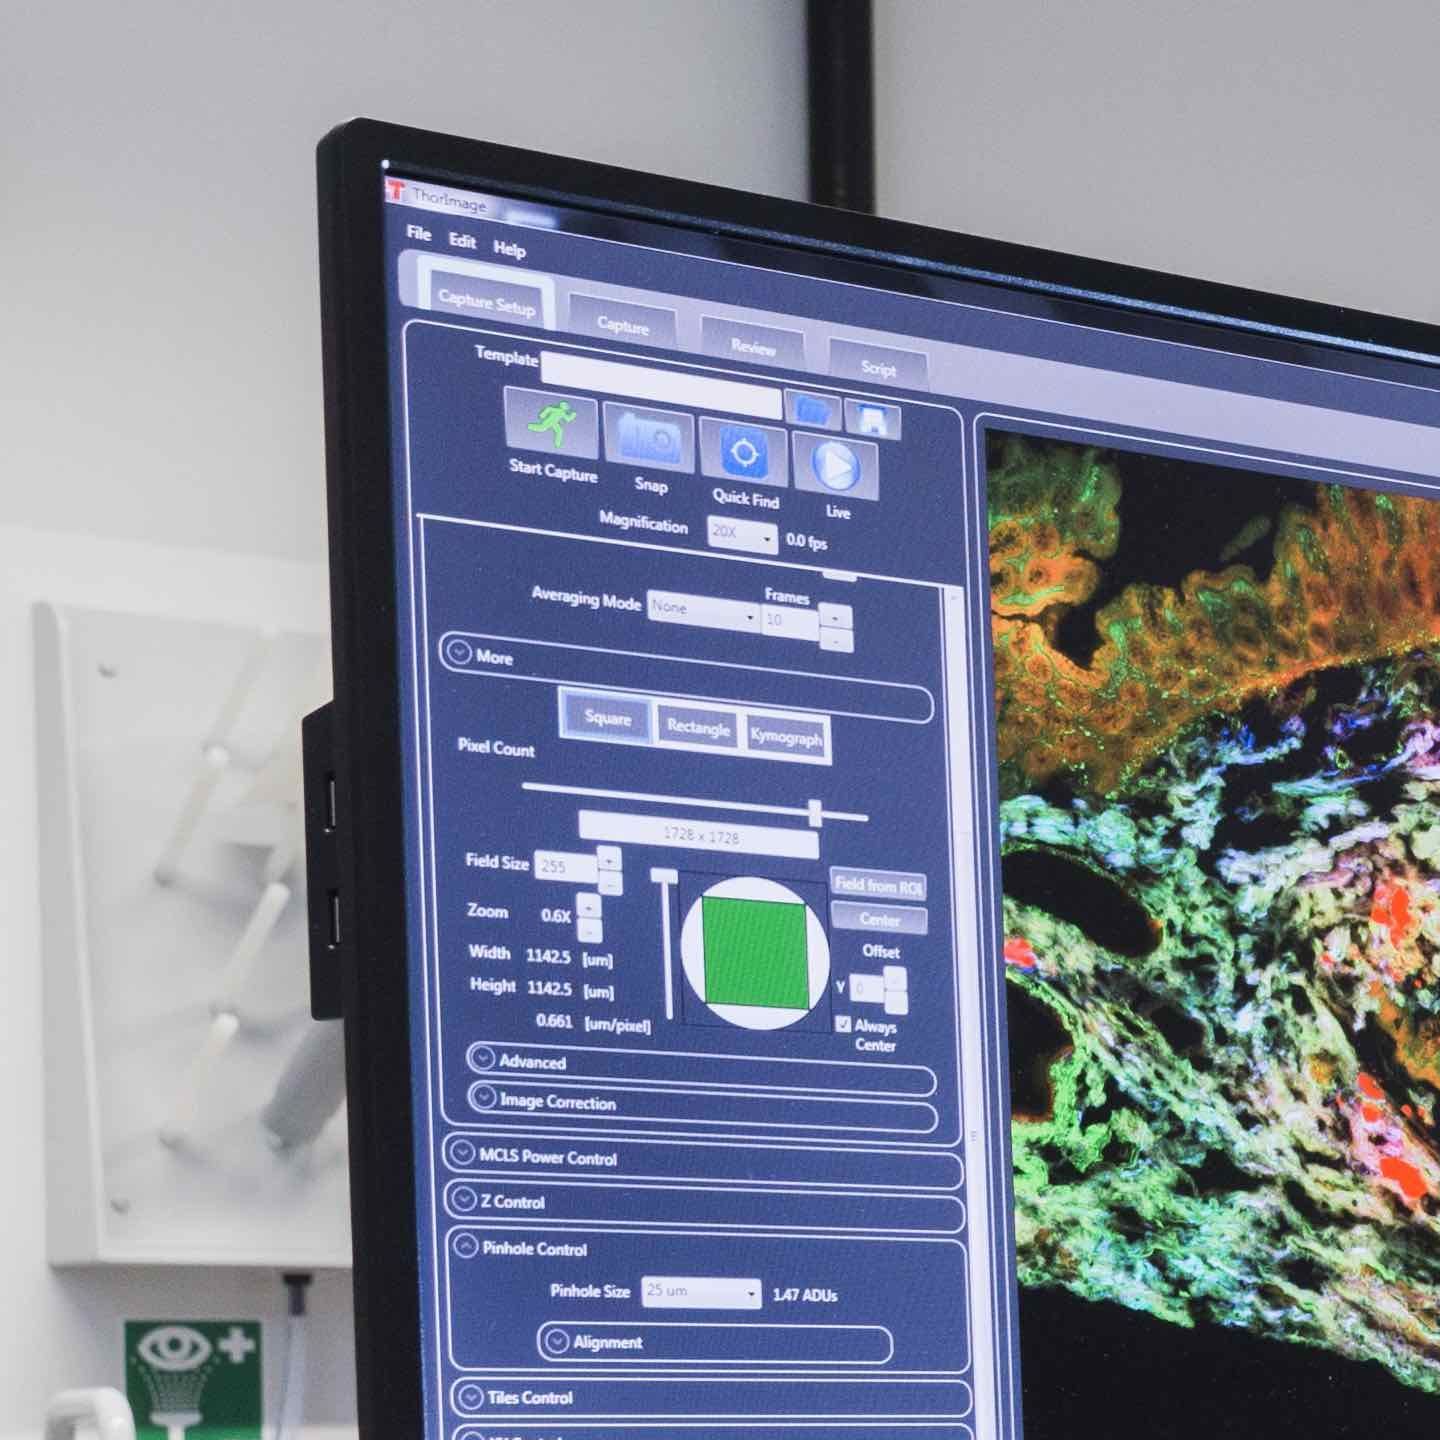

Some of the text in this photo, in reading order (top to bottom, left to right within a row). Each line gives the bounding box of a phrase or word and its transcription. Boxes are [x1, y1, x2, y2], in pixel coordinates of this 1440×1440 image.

[413, 187, 488, 213] ThorImage
[407, 224, 433, 242] File
[449, 231, 478, 250] Edit
[493, 239, 527, 261] Help
[438, 289, 537, 318] Capture Setup
[597, 316, 650, 338] Capture
[475, 344, 539, 369] Template
[731, 336, 776, 358] Review
[861, 359, 897, 380] Script
[509, 458, 598, 485] Start Capture
[634, 476, 669, 497] Snap
[713, 487, 780, 510] Quick Find
[826, 503, 852, 520] Live
[599, 509, 688, 536] Magnification
[711, 522, 737, 540] 20X
[786, 532, 828, 553] 0.0 fps
[532, 584, 642, 613] Averaging Mode
[764, 585, 811, 606] Frames
[652, 598, 688, 619] None
[765, 611, 783, 627] 10
[476, 647, 514, 666] More
[584, 707, 633, 732] Square
[667, 716, 731, 741] Rectangle
[457, 736, 536, 759] Pixel Count
[750, 725, 824, 750] Kymograph
[664, 825, 696, 842] 1728
[708, 829, 741, 846] 1728
[465, 852, 530, 872] Field Size
[540, 858, 567, 876] 255
[835, 875, 866, 892] Field
[867, 879, 897, 895] from
[467, 902, 509, 921] Zoom
[540, 907, 571, 925] 0.6X
[859, 911, 901, 928] Center
[469, 944, 512, 963] Width
[526, 947, 614, 971] 1142.5 [um]
[862, 943, 901, 960] Offset
[470, 976, 516, 996] Height
[527, 979, 615, 1002] 1142.5 [um]
[835, 980, 846, 994] Y
[535, 1013, 651, 1036] 0.661 [um/pixel]
[854, 1017, 898, 1037] Always
[854, 1037, 897, 1053] Center
[499, 1053, 567, 1071] Advanced
[500, 1091, 617, 1112] Image Correction
[479, 1146, 618, 1168] MCLS Power Control
[481, 1193, 546, 1211] Z Control
[482, 1239, 588, 1258] Pinhole Control
[550, 1282, 632, 1300] Pinhole Size
[646, 1283, 688, 1299] 25 um
[772, 1287, 838, 1305] 1.47 ADUs
[573, 1333, 644, 1353] Alignment
[487, 1389, 574, 1407] Tiles Control
